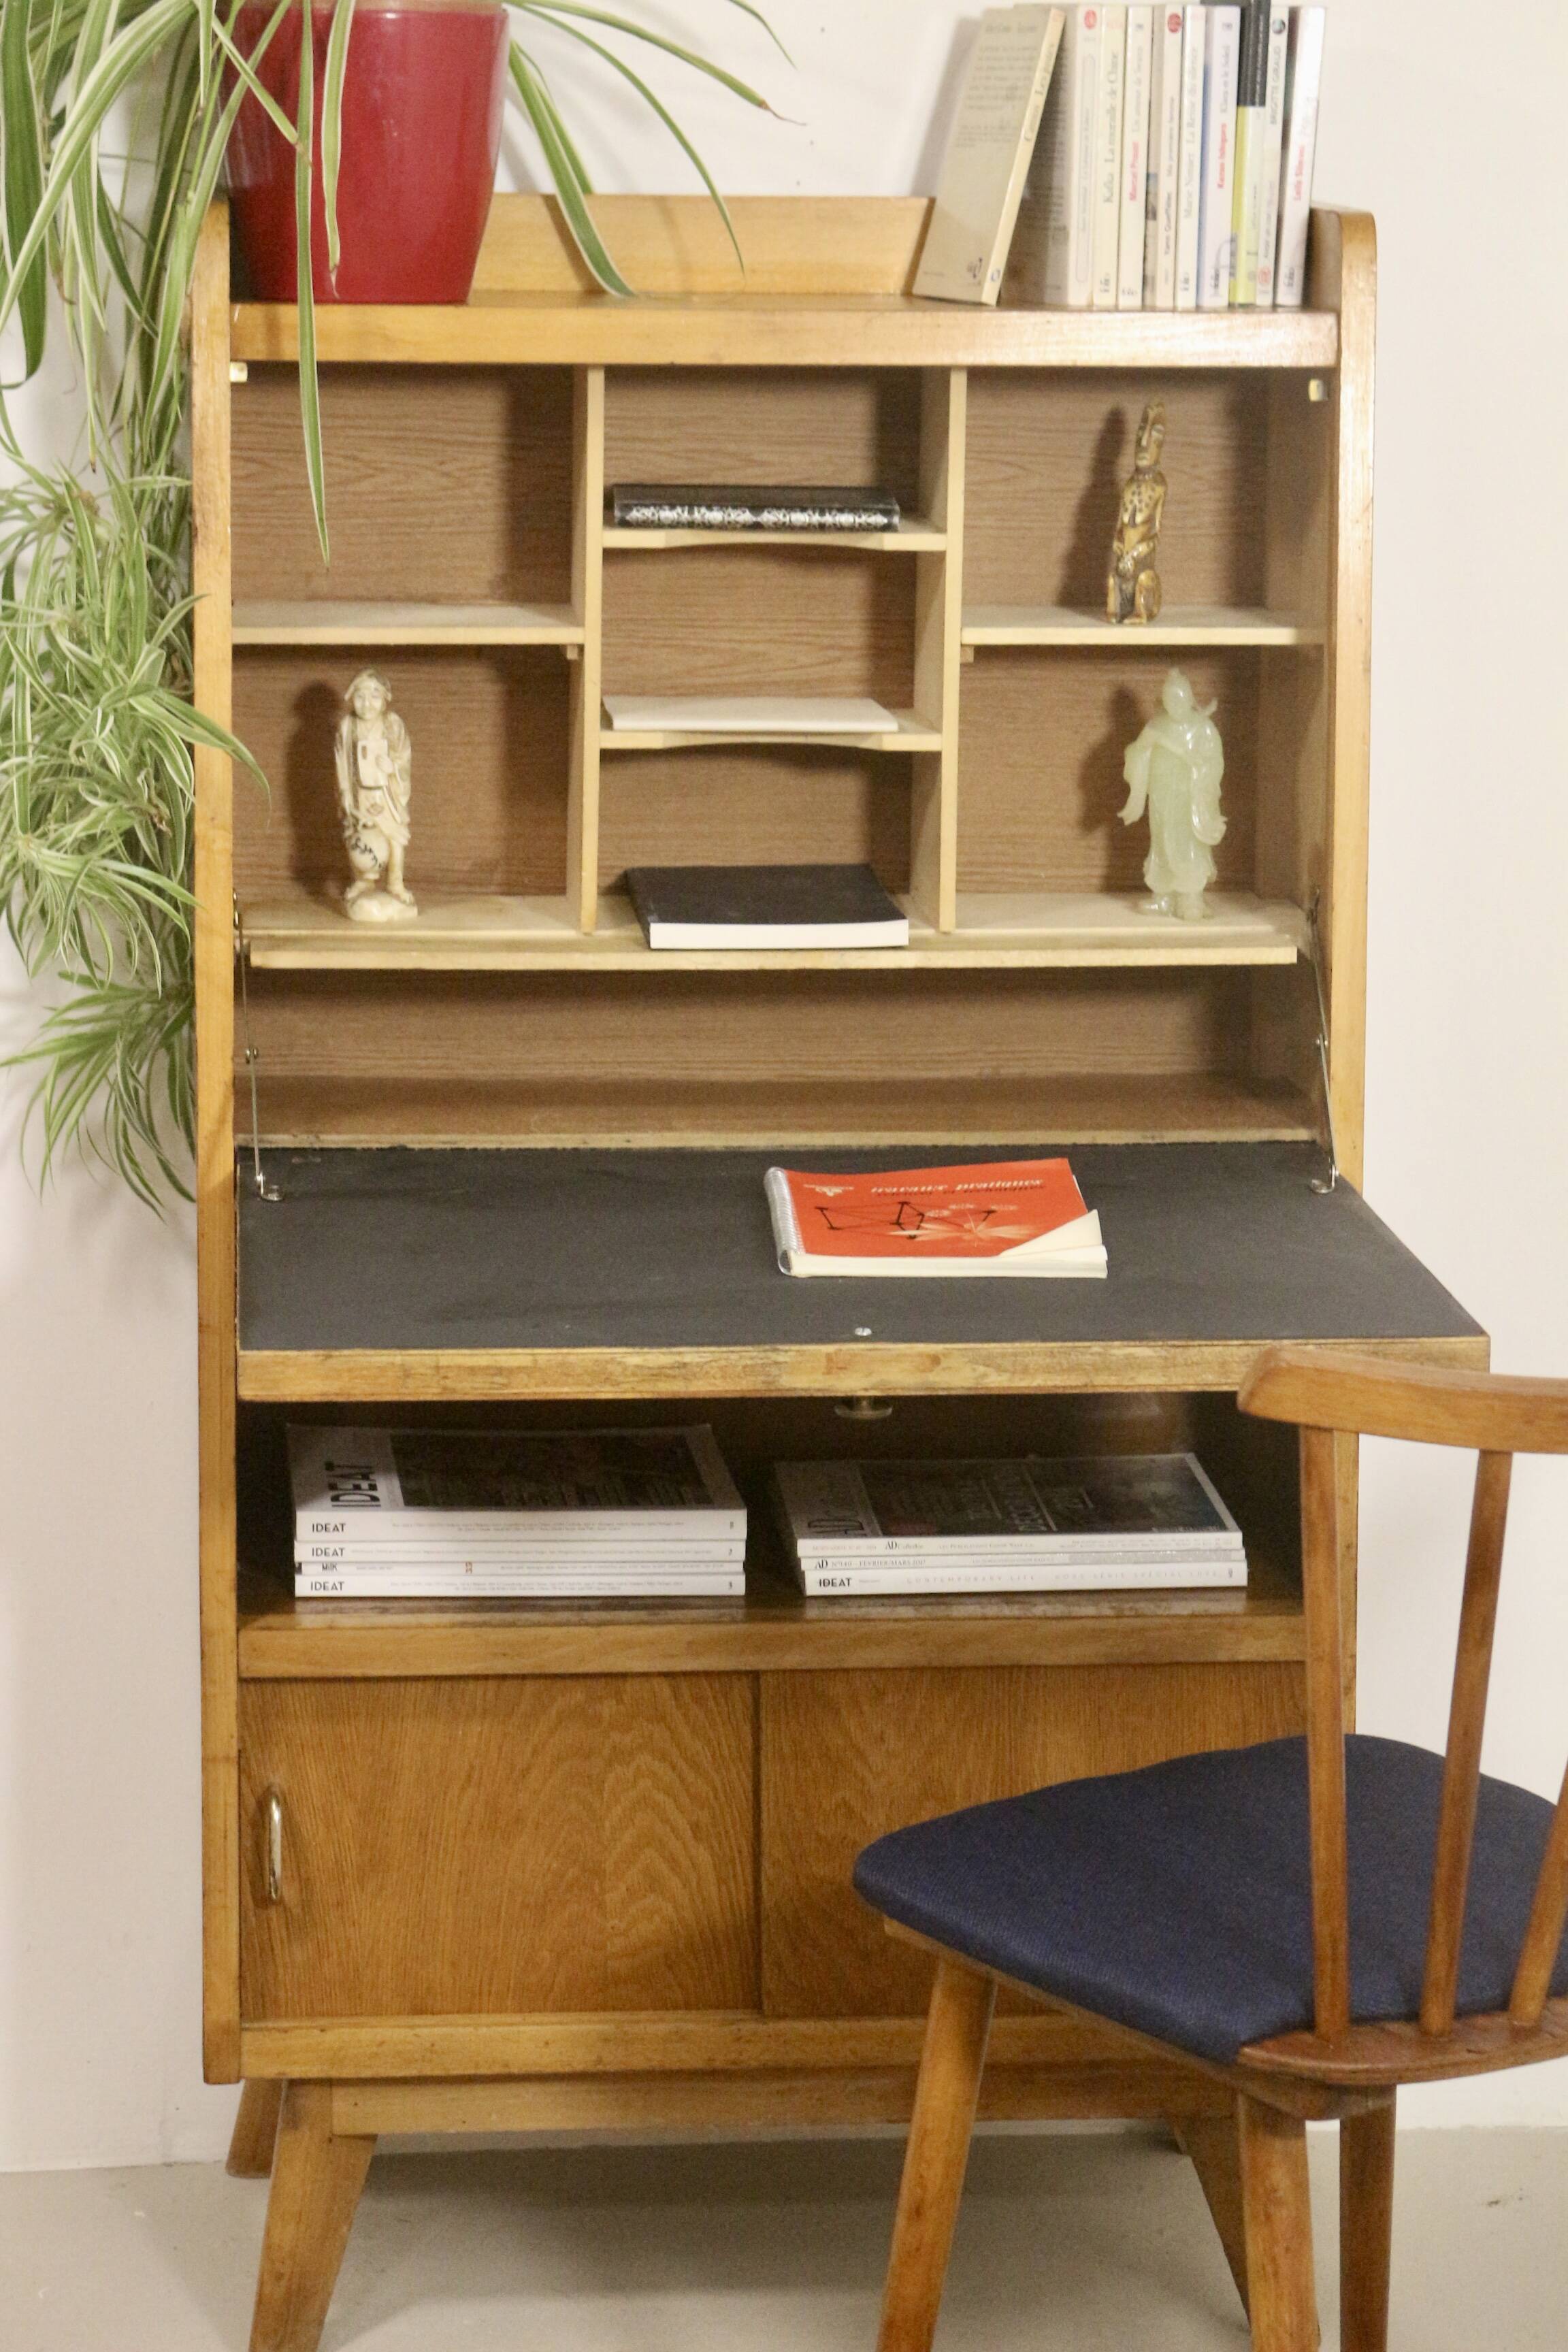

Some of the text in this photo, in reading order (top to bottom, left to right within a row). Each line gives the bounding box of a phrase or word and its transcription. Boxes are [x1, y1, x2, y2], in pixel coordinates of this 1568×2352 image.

[323, 1460, 382, 1508] IDEAT
[311, 1522, 346, 1533] IDEAT
[311, 1546, 346, 1557] IDEAT
[310, 1580, 345, 1592] IDEAT
[818, 1577, 853, 1588] IDEAT
